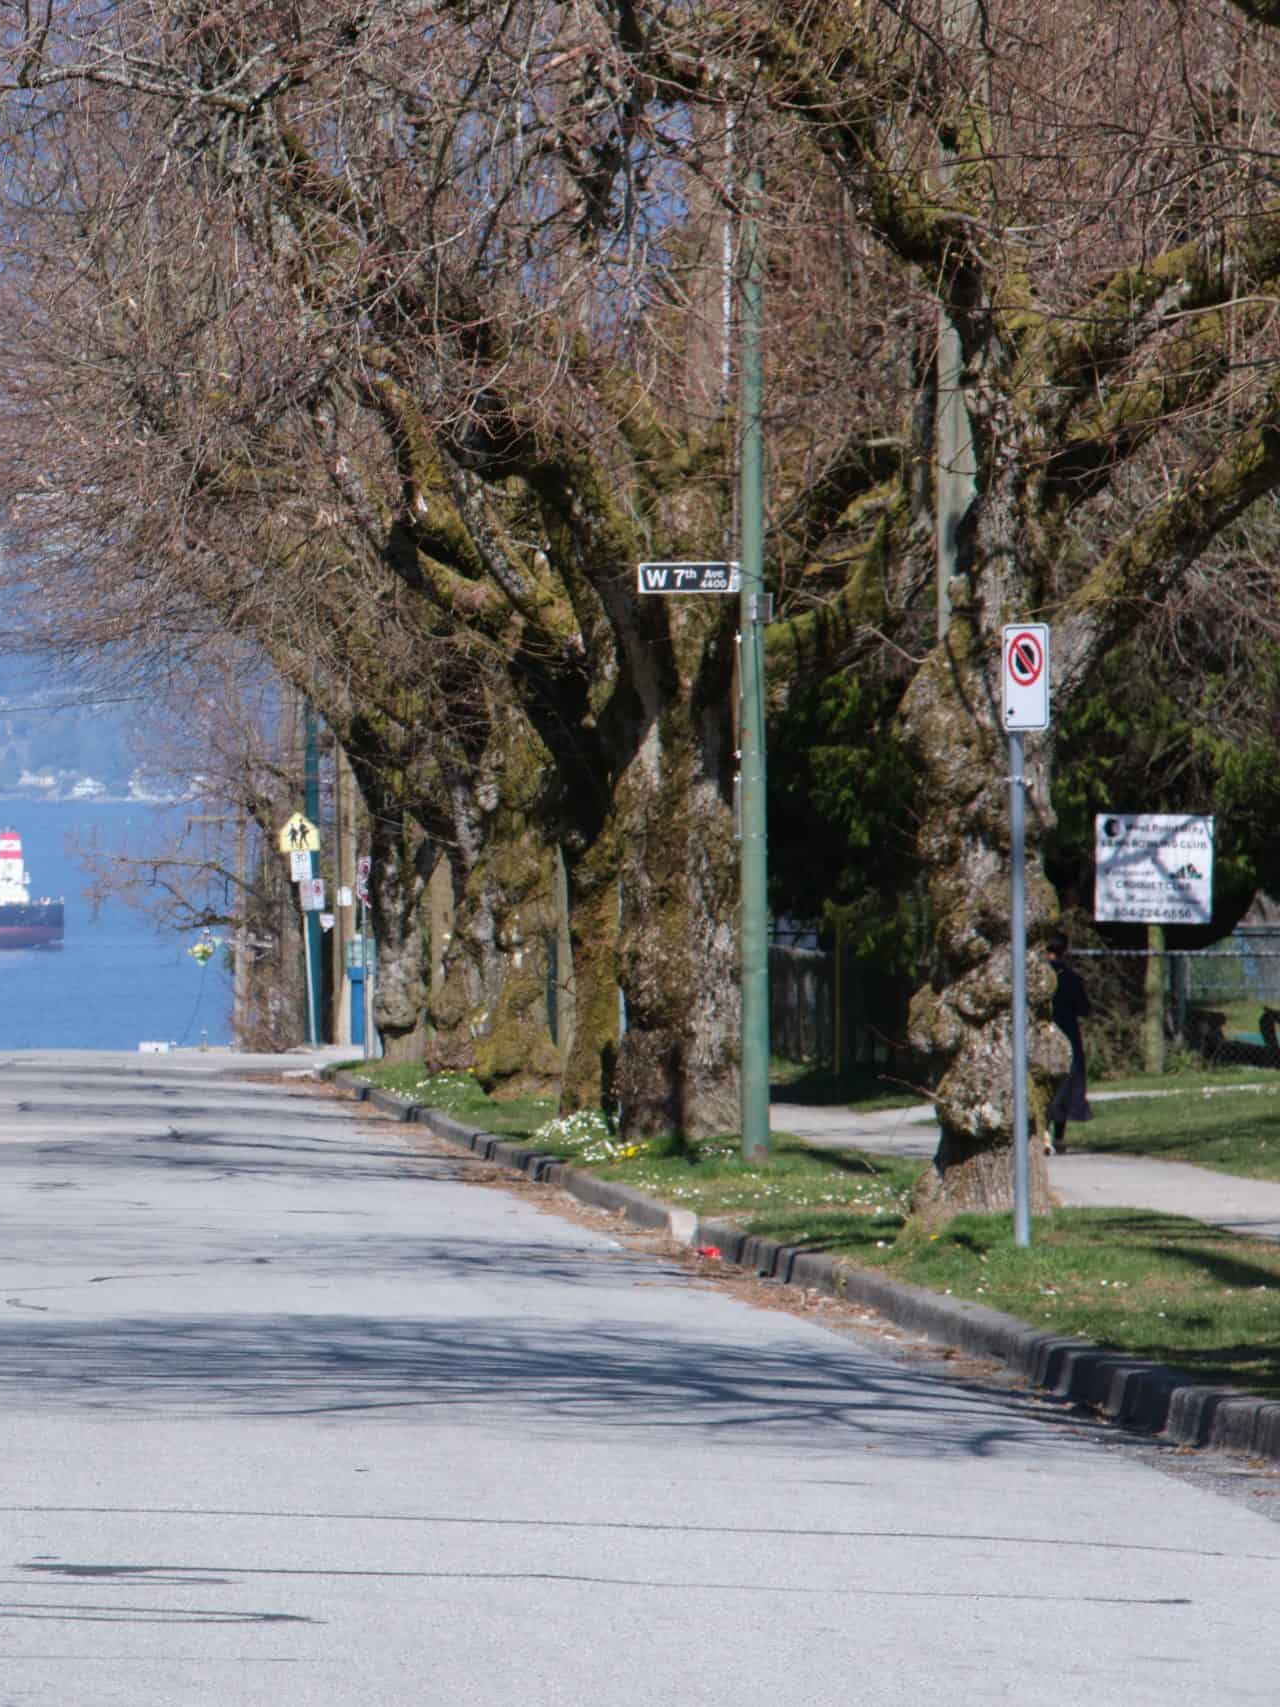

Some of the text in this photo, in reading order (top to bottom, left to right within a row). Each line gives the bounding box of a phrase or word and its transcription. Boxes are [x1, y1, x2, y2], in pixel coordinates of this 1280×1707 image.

[646, 568, 725, 588] W 7th Ave
[700, 578, 727, 588] 4400
[1180, 840, 1207, 848] CLUB
